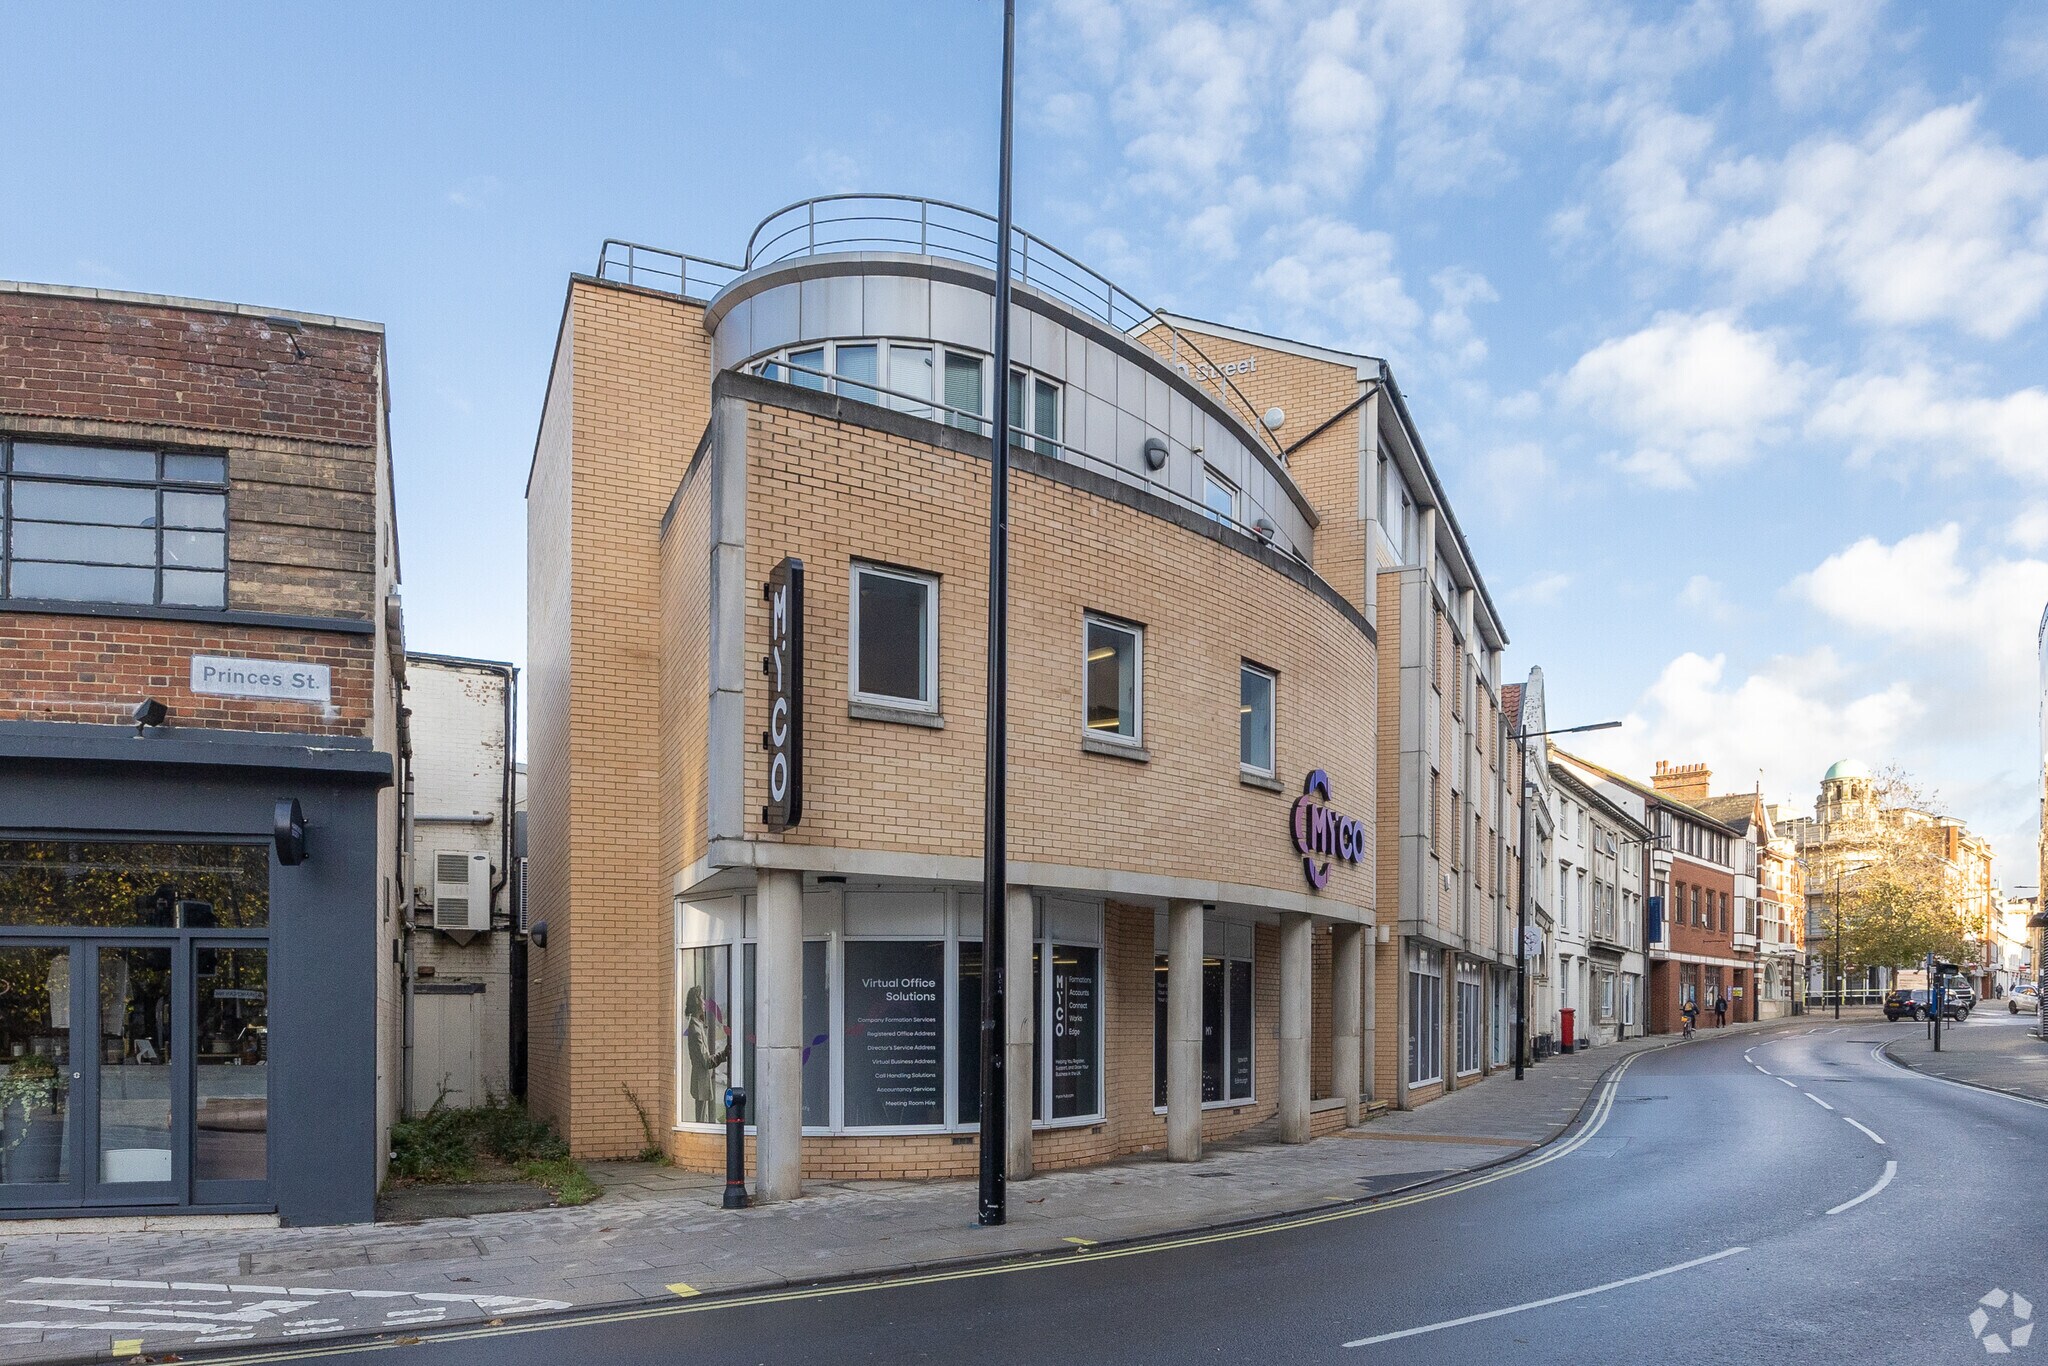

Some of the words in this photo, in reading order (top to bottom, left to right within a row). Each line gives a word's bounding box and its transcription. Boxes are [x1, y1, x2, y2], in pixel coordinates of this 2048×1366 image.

[1195, 355, 1257, 381] Street
[203, 666, 282, 686] Princes
[291, 673, 320, 689] St.
[771, 584, 788, 802] MYCO
[1309, 804, 1365, 864] MYCO
[861, 978, 899, 988] Virtual
[901, 978, 936, 988] Office
[1069, 975, 1092, 983] Formations
[886, 991, 936, 1001] Solutions
[1069, 988, 1090, 996] Accounts
[1055, 975, 1064, 1037] MYCO
[1069, 1001, 1088, 1009] Connect
[1068, 1027, 1080, 1037] Edge
